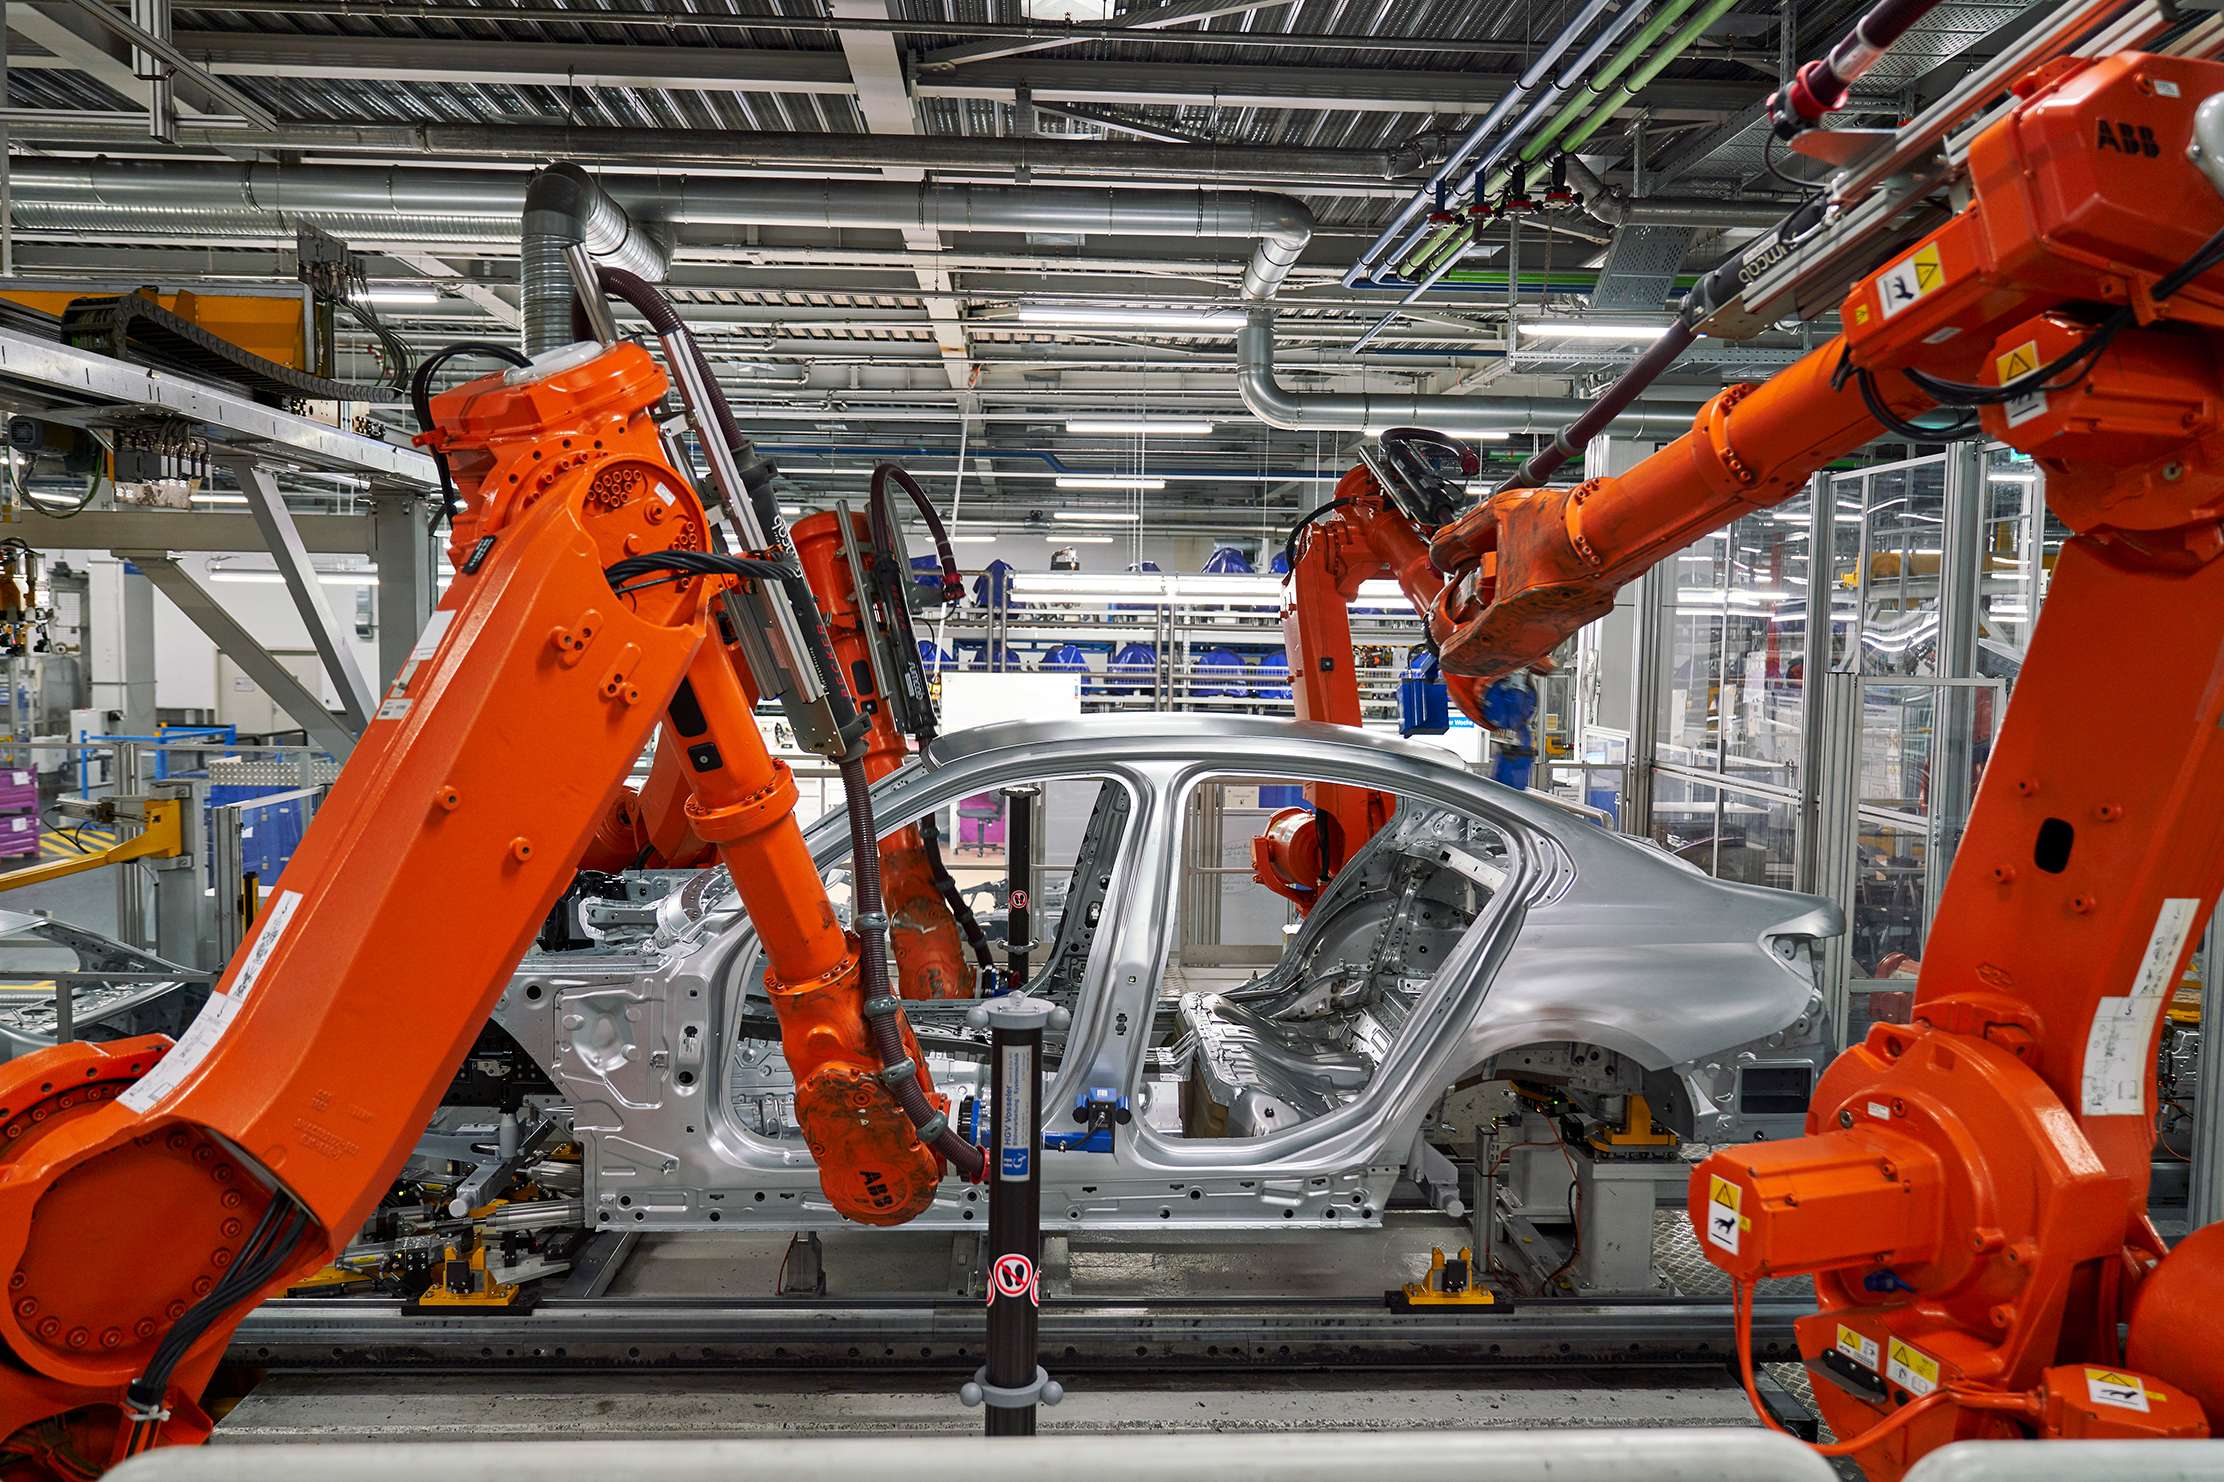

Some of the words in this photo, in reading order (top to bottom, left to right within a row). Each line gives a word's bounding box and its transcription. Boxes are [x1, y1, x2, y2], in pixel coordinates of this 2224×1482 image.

[2097, 119, 2160, 158] ABB
[1738, 244, 1788, 283] mcab
[1004, 1086, 1012, 1123] Vosseler
[1004, 1125, 1012, 1145] HGV
[859, 1171, 893, 1208] ABB
